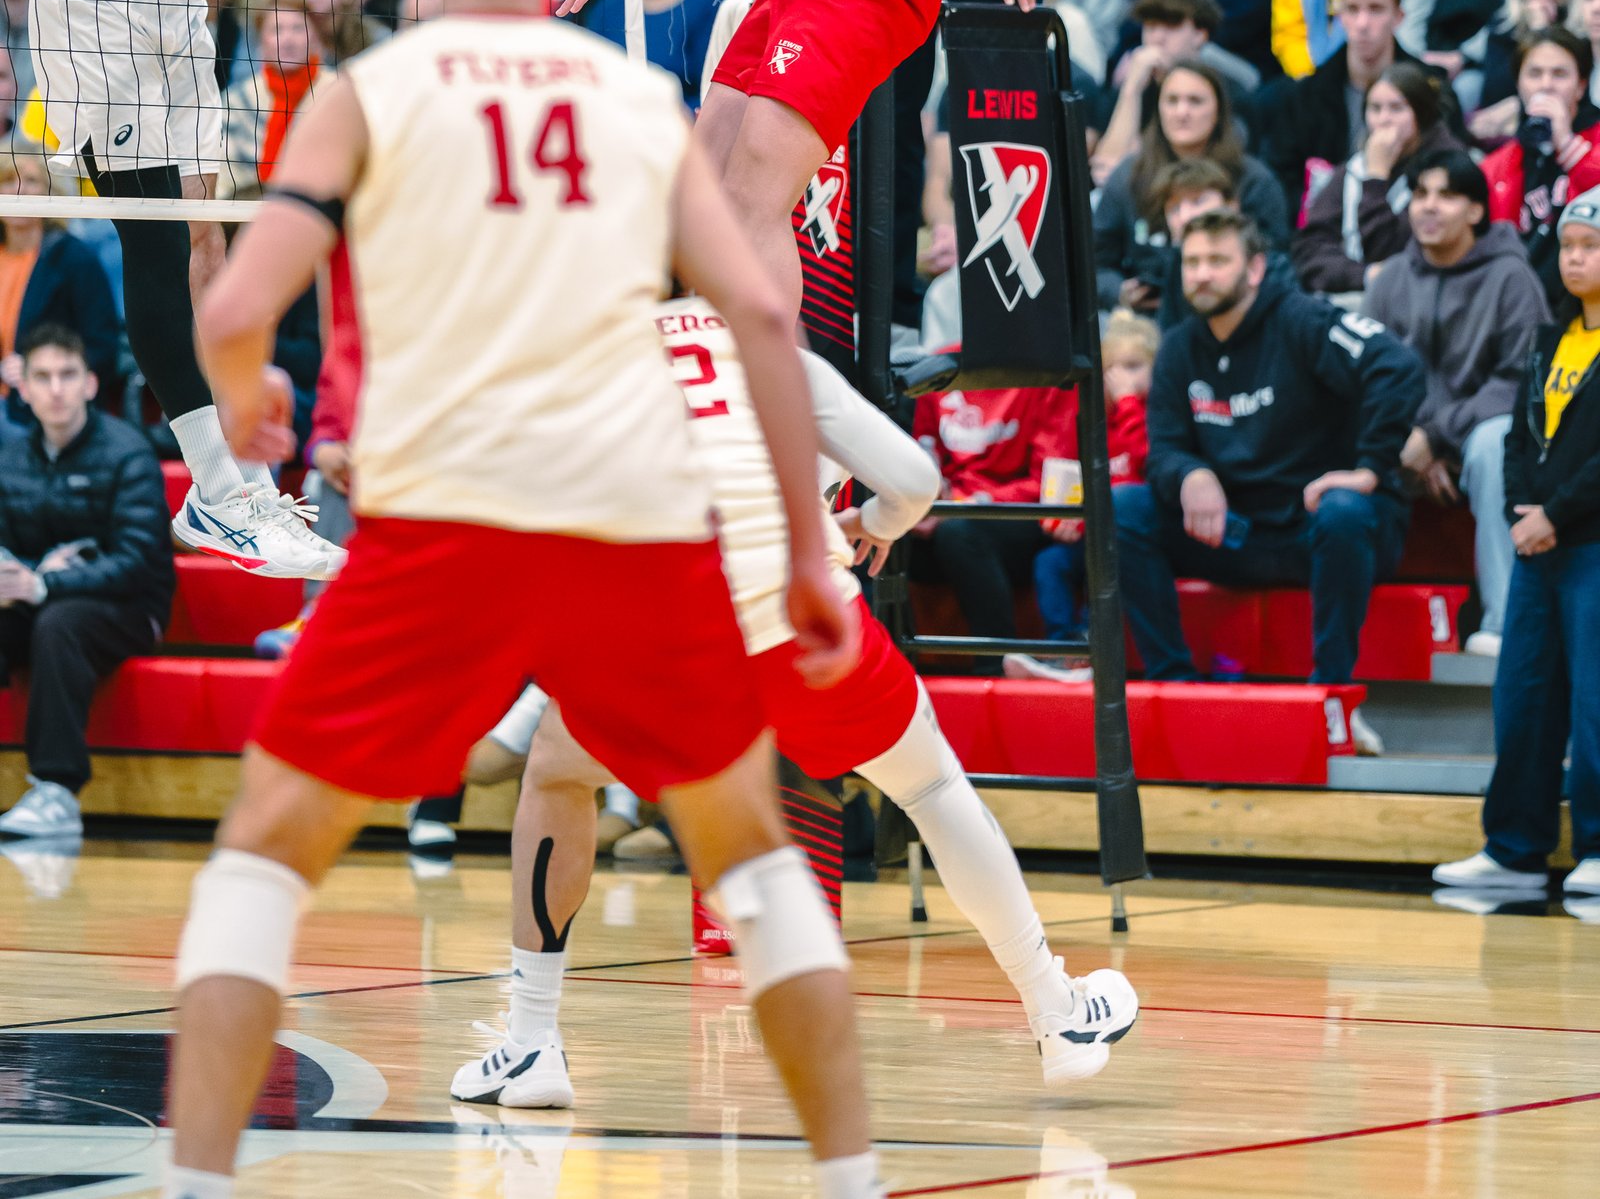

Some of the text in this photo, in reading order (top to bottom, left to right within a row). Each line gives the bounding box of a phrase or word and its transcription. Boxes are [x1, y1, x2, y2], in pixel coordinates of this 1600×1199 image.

[778, 39, 804, 52] LEWIS
[436, 53, 601, 89] FLYERS
[967, 88, 1038, 120] LEWIS
[479, 100, 592, 209] 14
